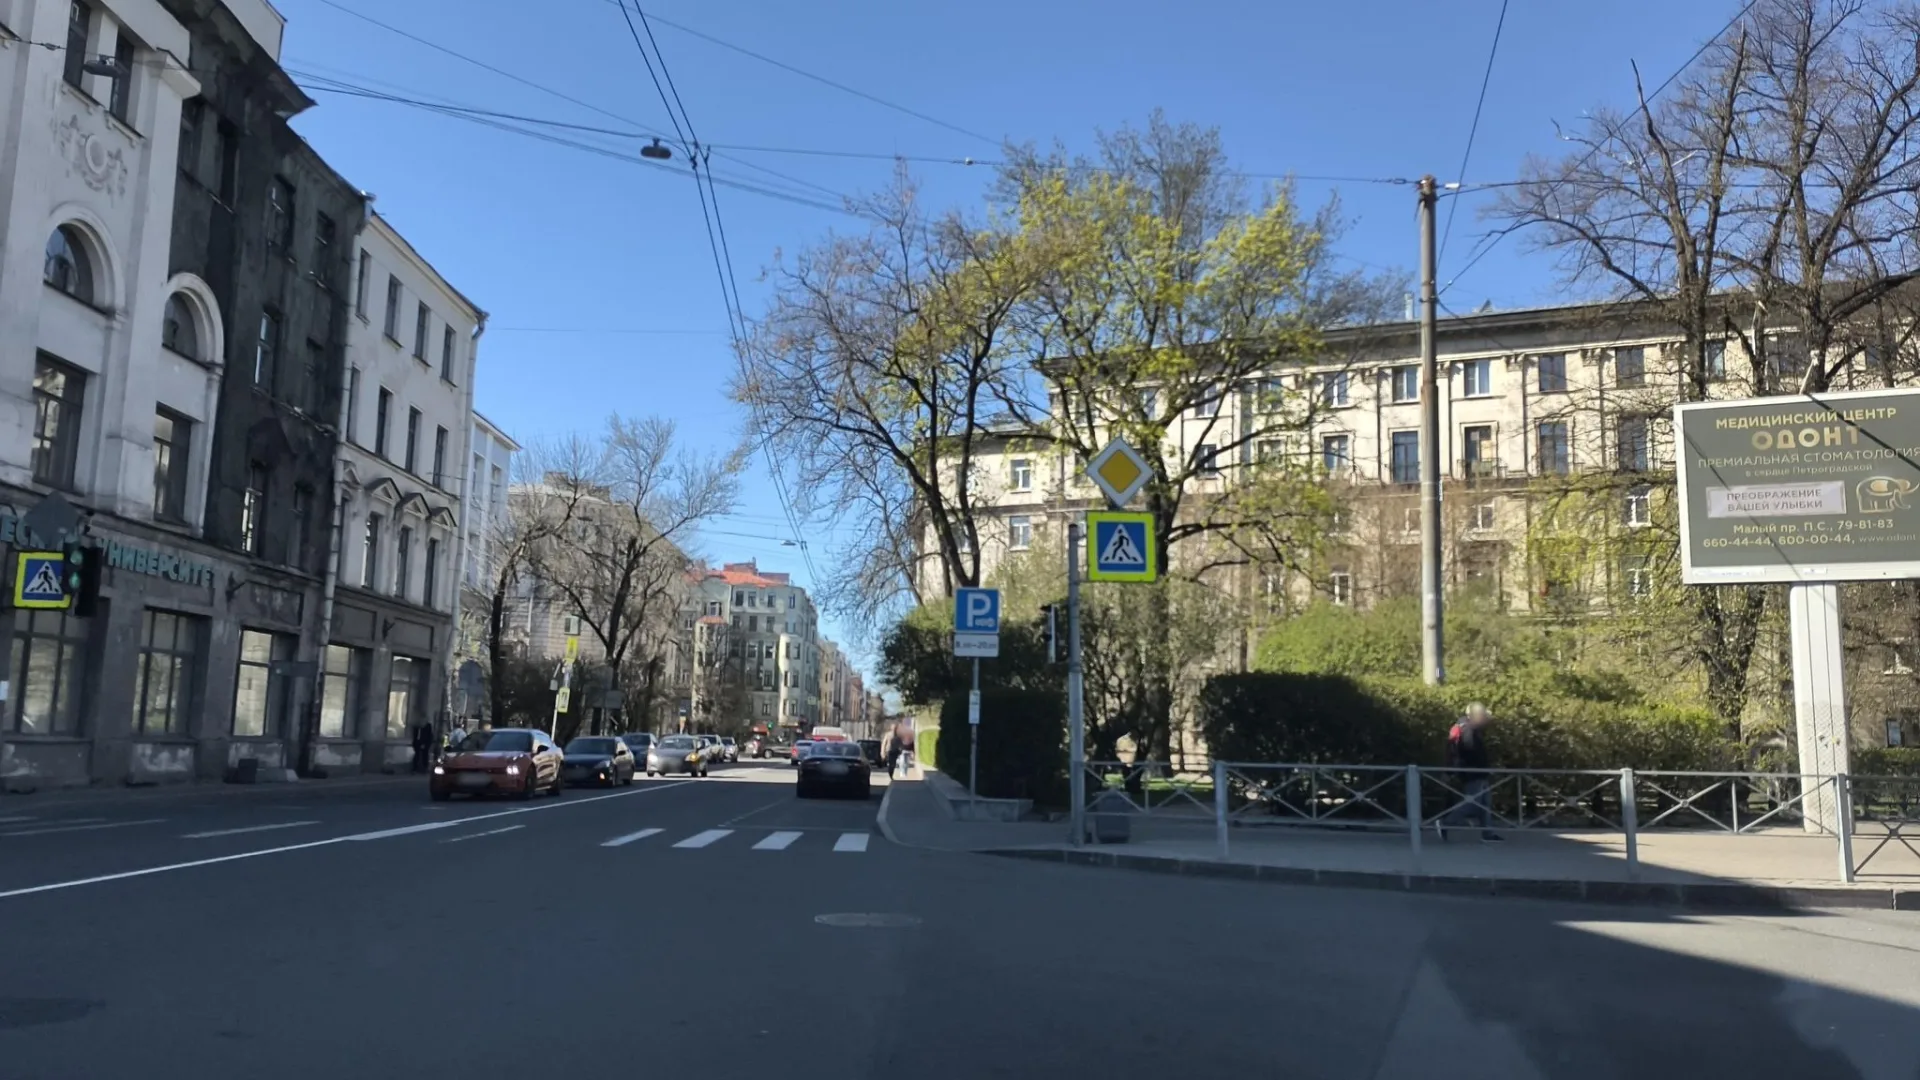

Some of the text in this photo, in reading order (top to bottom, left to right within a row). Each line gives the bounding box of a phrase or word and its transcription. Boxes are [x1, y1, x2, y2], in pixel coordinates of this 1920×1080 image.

[1716, 407, 1897, 430] МЕДИЦИНСКИЙ ЦЕНТР
[1751, 425, 1860, 450] ОДОНТ
[1698, 453, 1800, 469] ПРЕМИАЛЬНАЯ
[1754, 467, 1789, 477] сердце
[1792, 463, 1873, 475] Петроградской
[1726, 488, 1822, 502] ПРЕОБРАЖЕНИЕ
[1727, 499, 1823, 512] ВАШЕЙ УЛЫБКИ
[1733, 523, 1777, 534] Малый
[1780, 523, 1800, 534] пр.
[1837, 519, 1894, 531] 79-81-83
[1703, 536, 1775, 548] 660-44-44,
[1778, 533, 1856, 546] 600-00-44,
